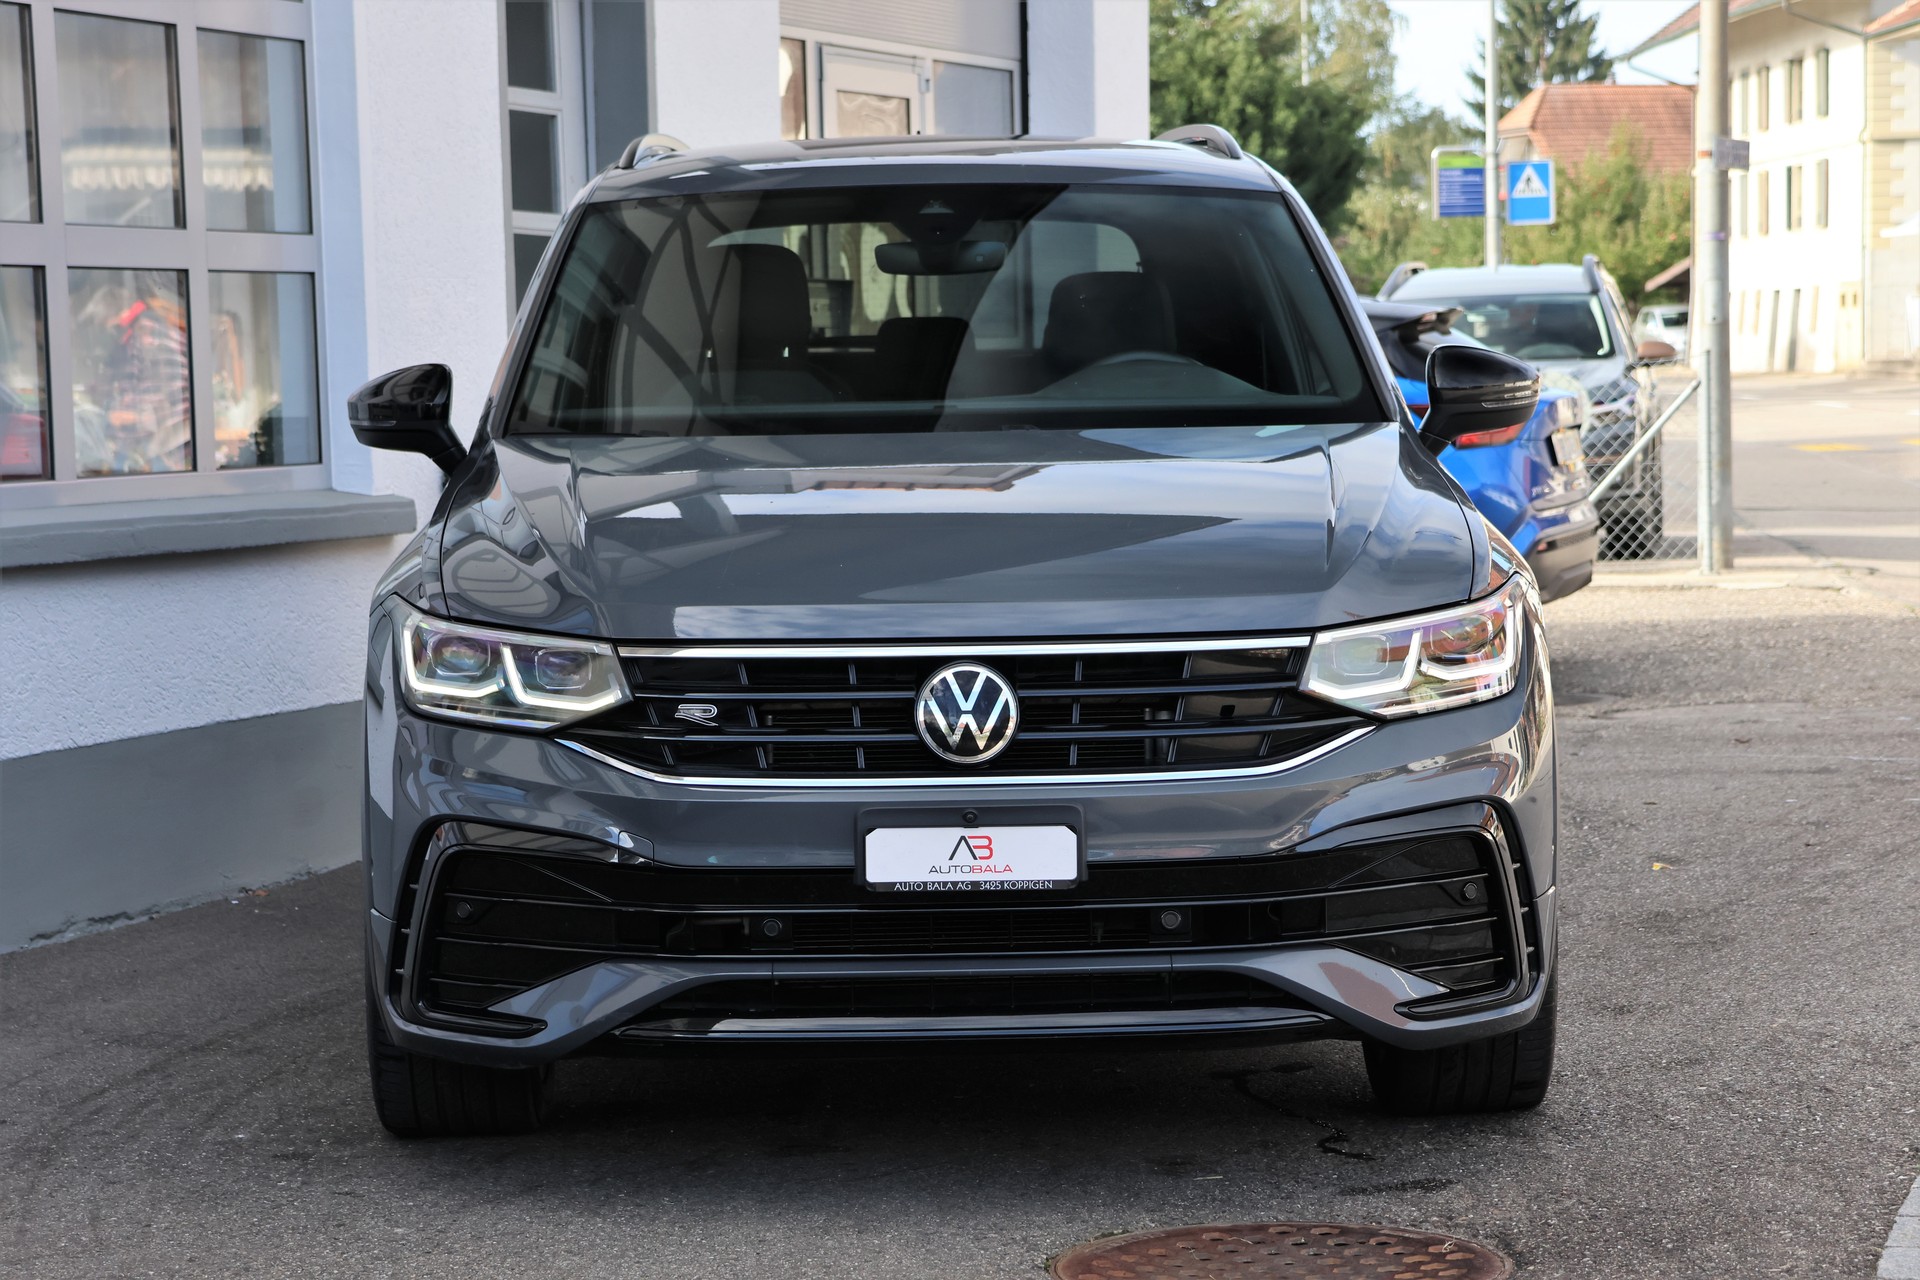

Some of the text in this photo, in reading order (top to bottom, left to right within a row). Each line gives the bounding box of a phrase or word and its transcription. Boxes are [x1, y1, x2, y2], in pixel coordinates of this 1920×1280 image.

[920, 666, 1011, 752] VW
[928, 864, 1013, 874] AUTOBALA
[894, 880, 1053, 891] AUTO BALA AG 3425 KOPPIGEN
